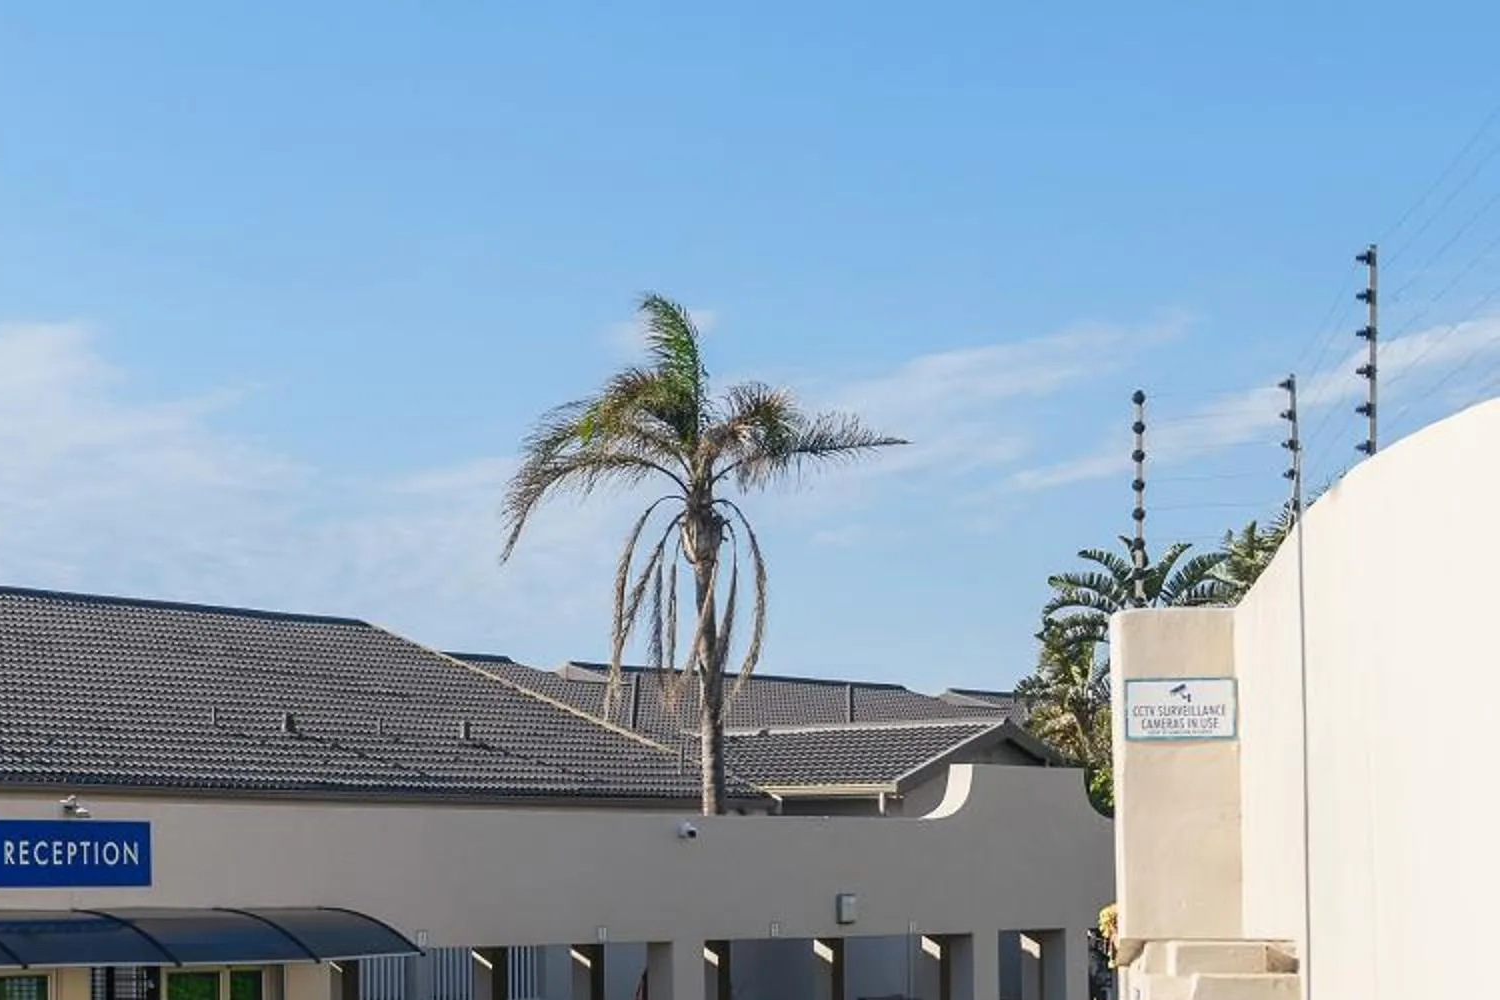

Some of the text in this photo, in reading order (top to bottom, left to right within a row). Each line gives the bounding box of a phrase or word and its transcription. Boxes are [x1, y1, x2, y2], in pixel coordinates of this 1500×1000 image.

[1133, 704, 1226, 717] CCTV SURVEILLANCE
[1141, 717, 1220, 730] CAMERAS IN USE
[3, 840, 140, 866] RECEPTION
